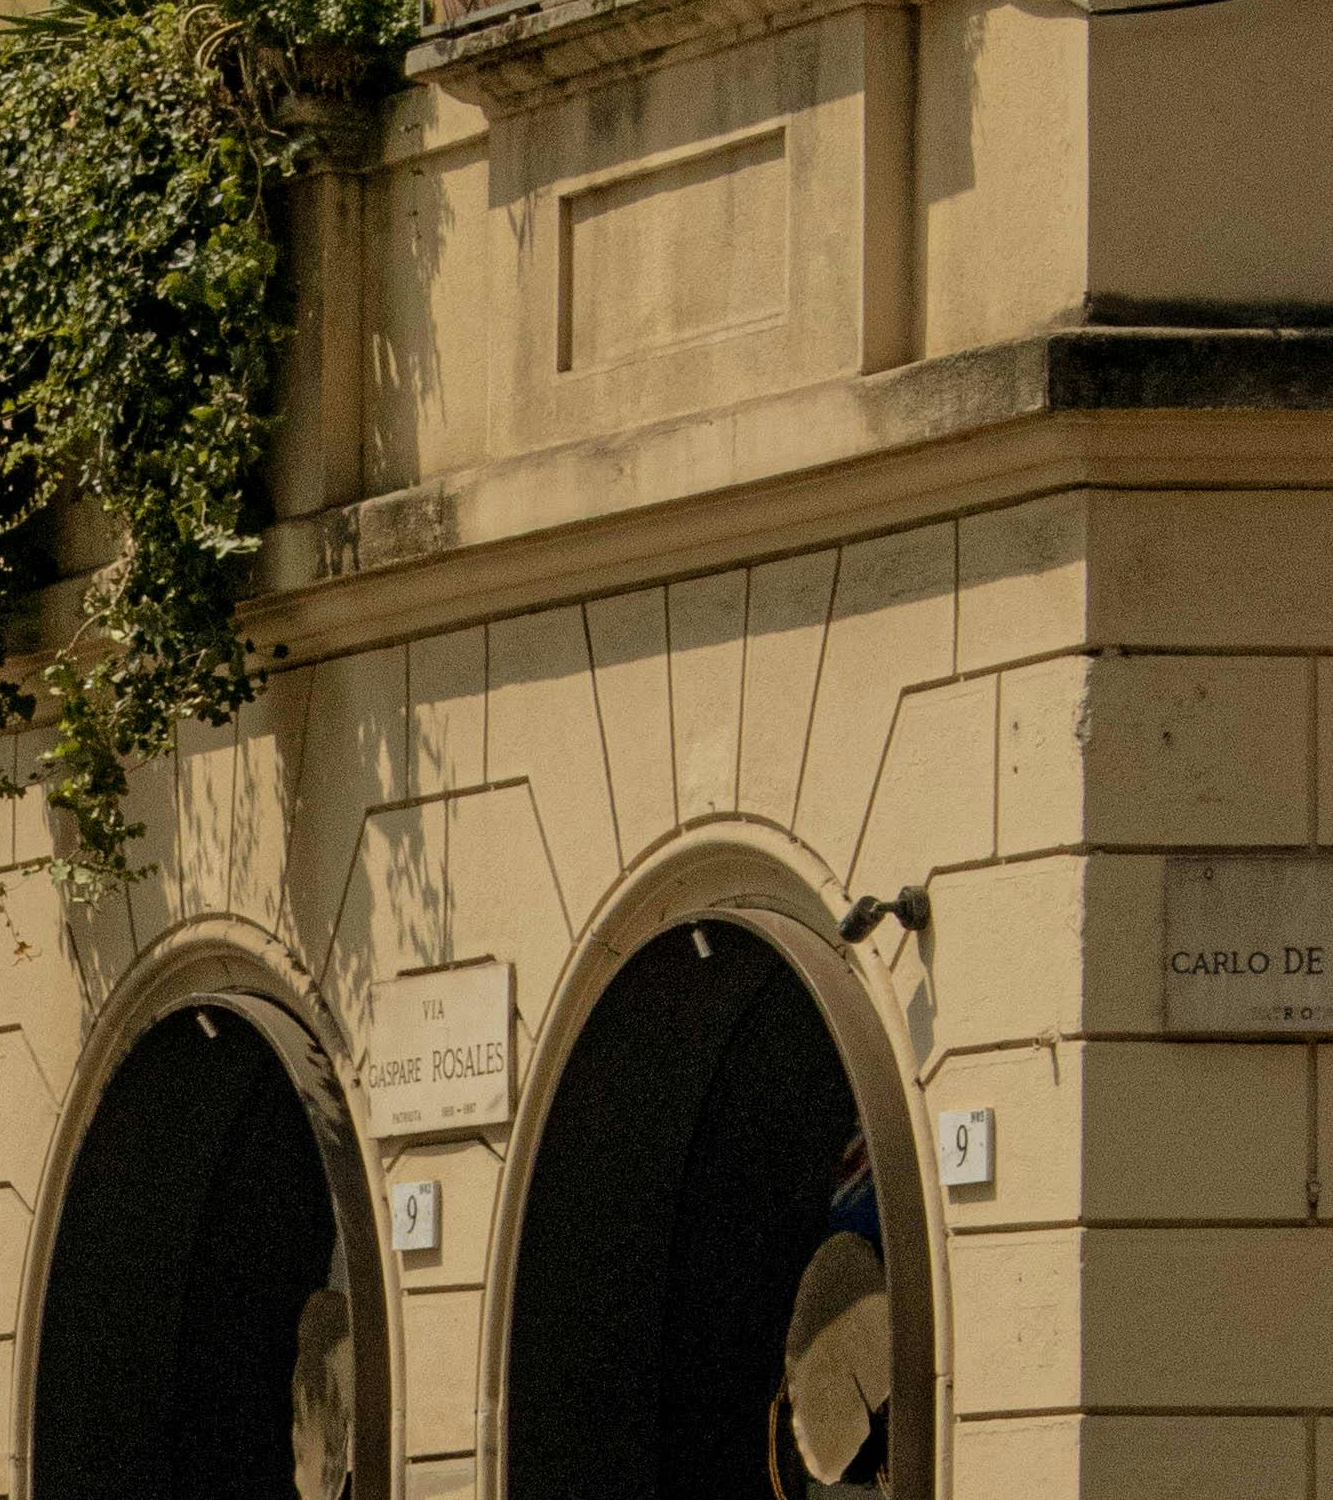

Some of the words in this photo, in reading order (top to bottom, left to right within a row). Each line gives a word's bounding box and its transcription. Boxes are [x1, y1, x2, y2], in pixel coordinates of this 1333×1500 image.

[1171, 951, 1271, 975] CARLO
[1283, 947, 1324, 975] DE
[422, 1000, 445, 1020] VIA
[368, 1056, 423, 1089] GASPARE
[433, 1041, 505, 1083] ROSALES
[956, 1124, 968, 1168] 9
[406, 1195, 418, 1234] 9
